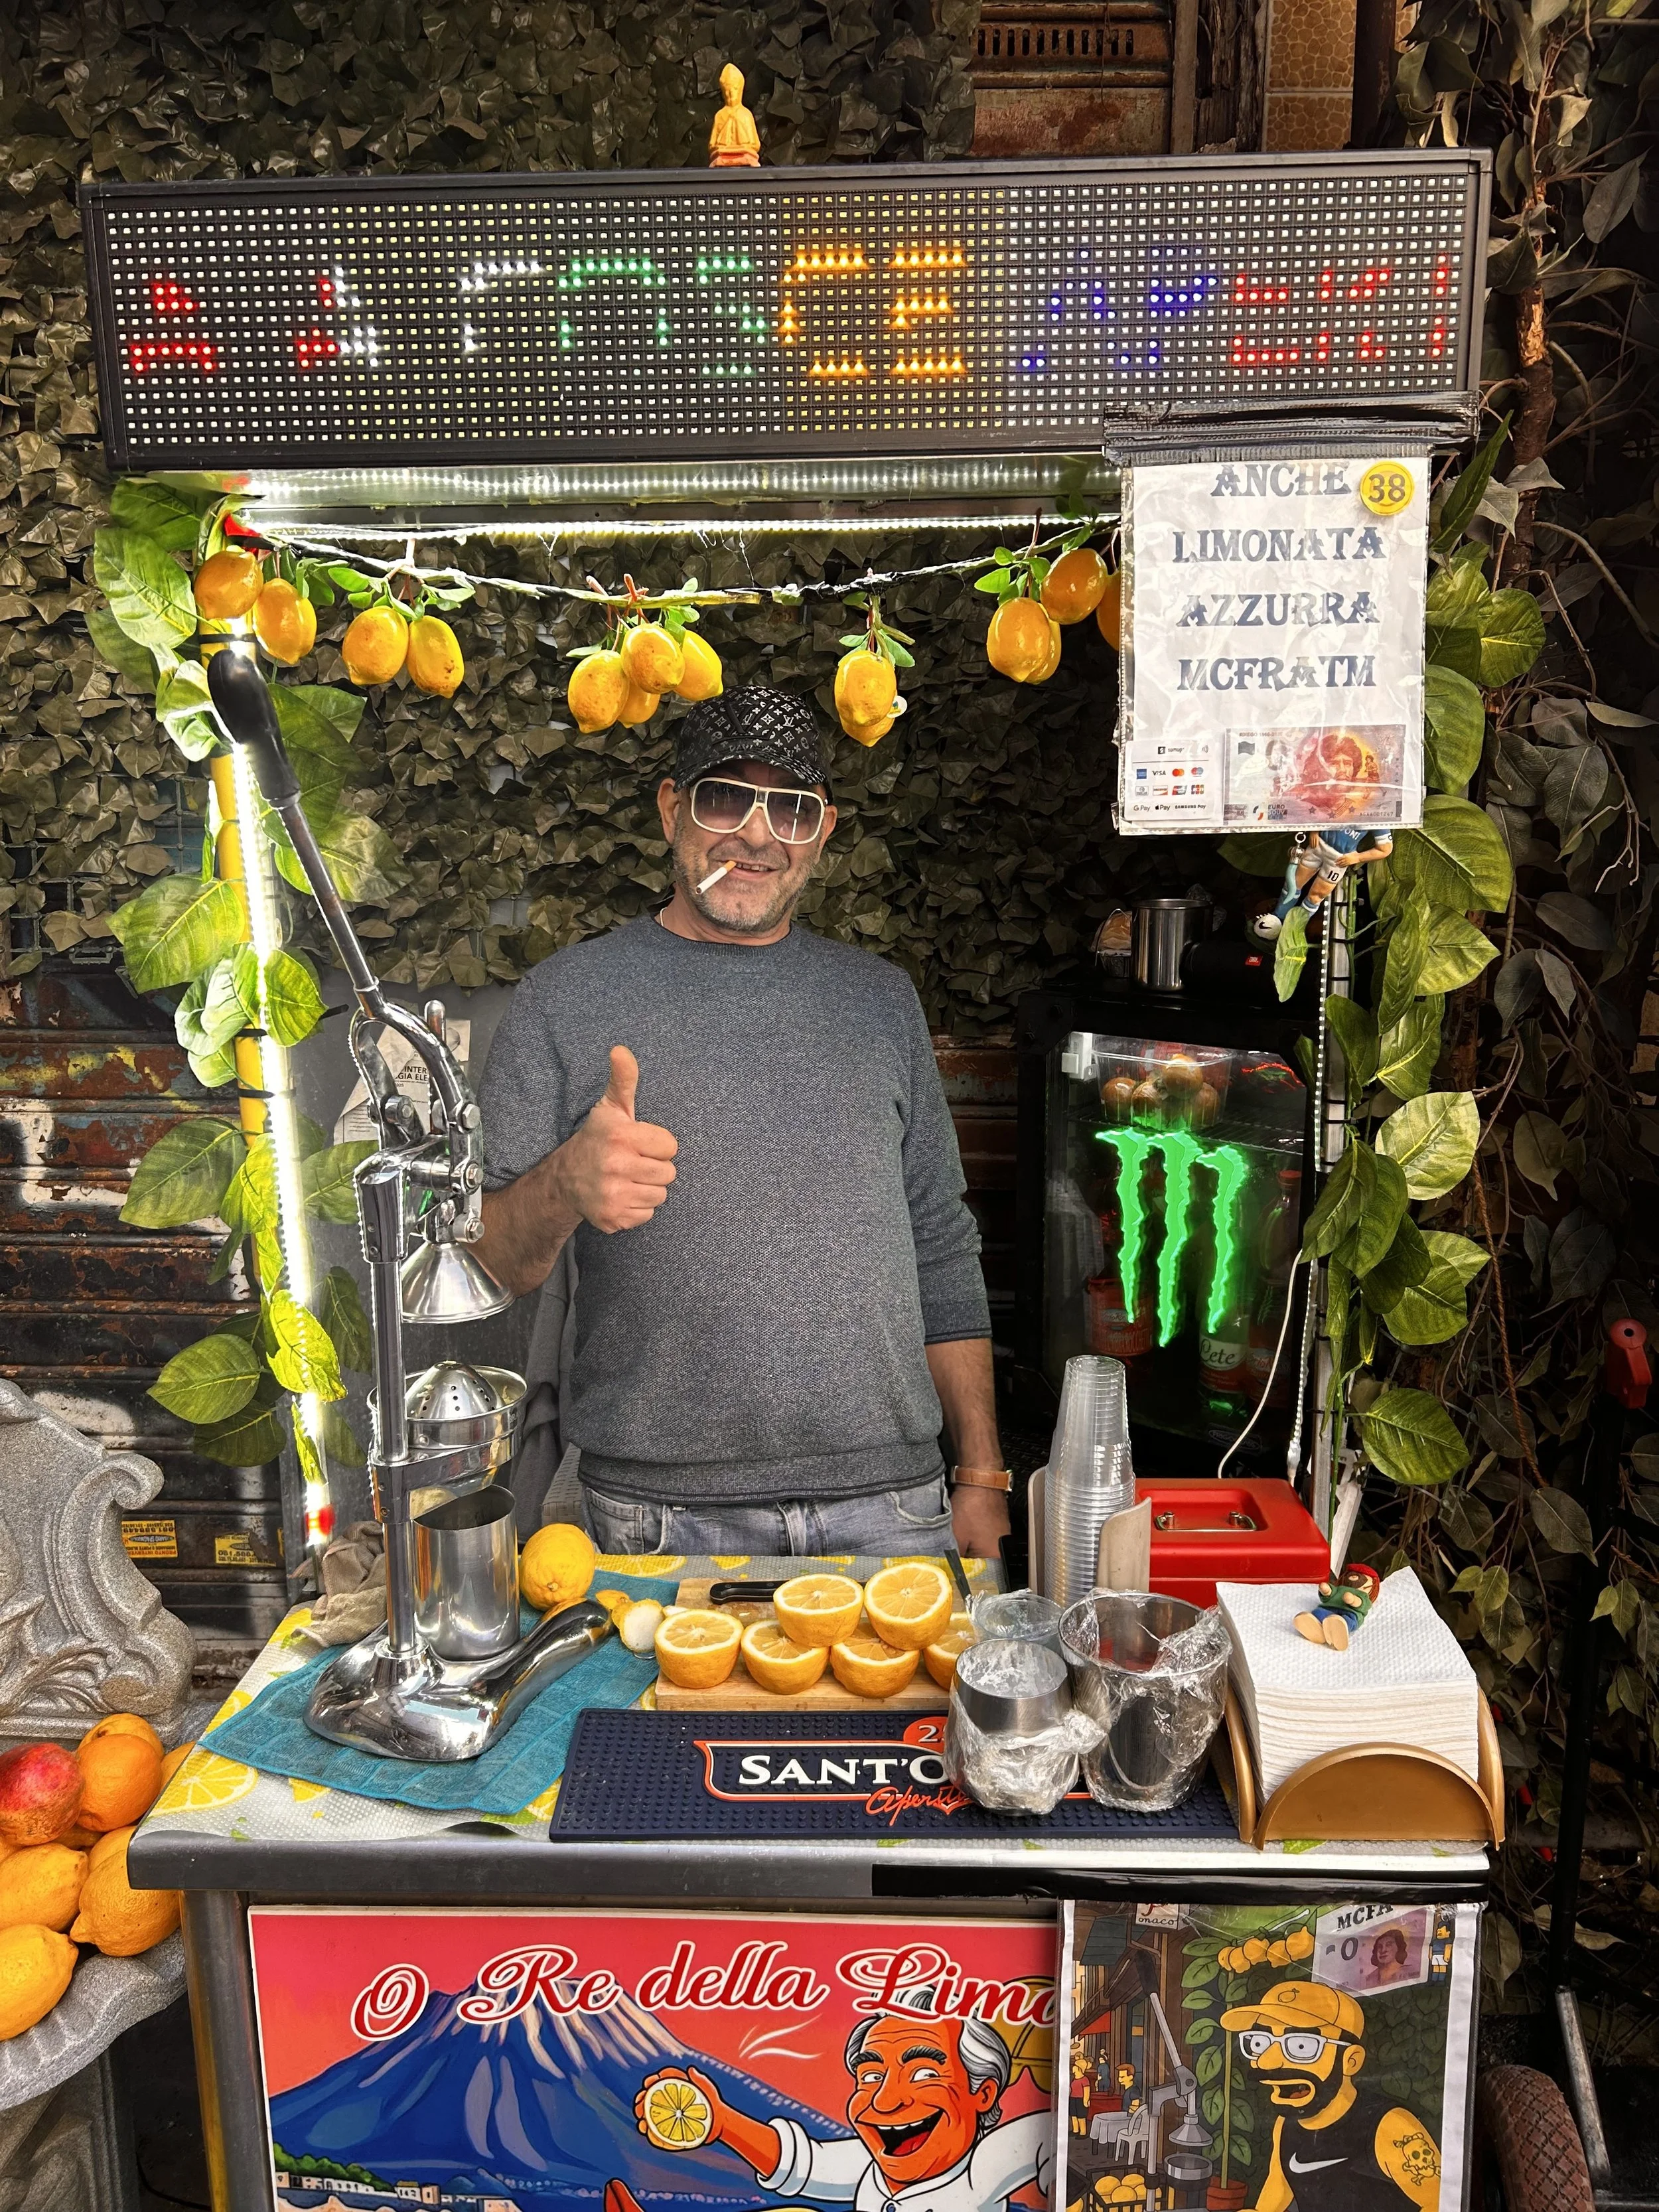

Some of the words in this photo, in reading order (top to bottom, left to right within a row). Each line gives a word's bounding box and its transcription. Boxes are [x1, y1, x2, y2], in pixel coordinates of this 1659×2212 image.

[1210, 462, 1352, 497] ANCHE
[1368, 473, 1406, 503] 38
[1172, 526, 1387, 563] LIMONATA
[1176, 591, 1381, 628] AZZURRA
[1177, 655, 1377, 692] MCFRATM
[1327, 870, 1339, 881] 10
[404, 1065, 427, 1074] INTER
[918, 1724, 945, 1743] 2
[350, 1962, 430, 2041] O
[456, 1943, 624, 2024] Re
[636, 1940, 830, 2012] della
